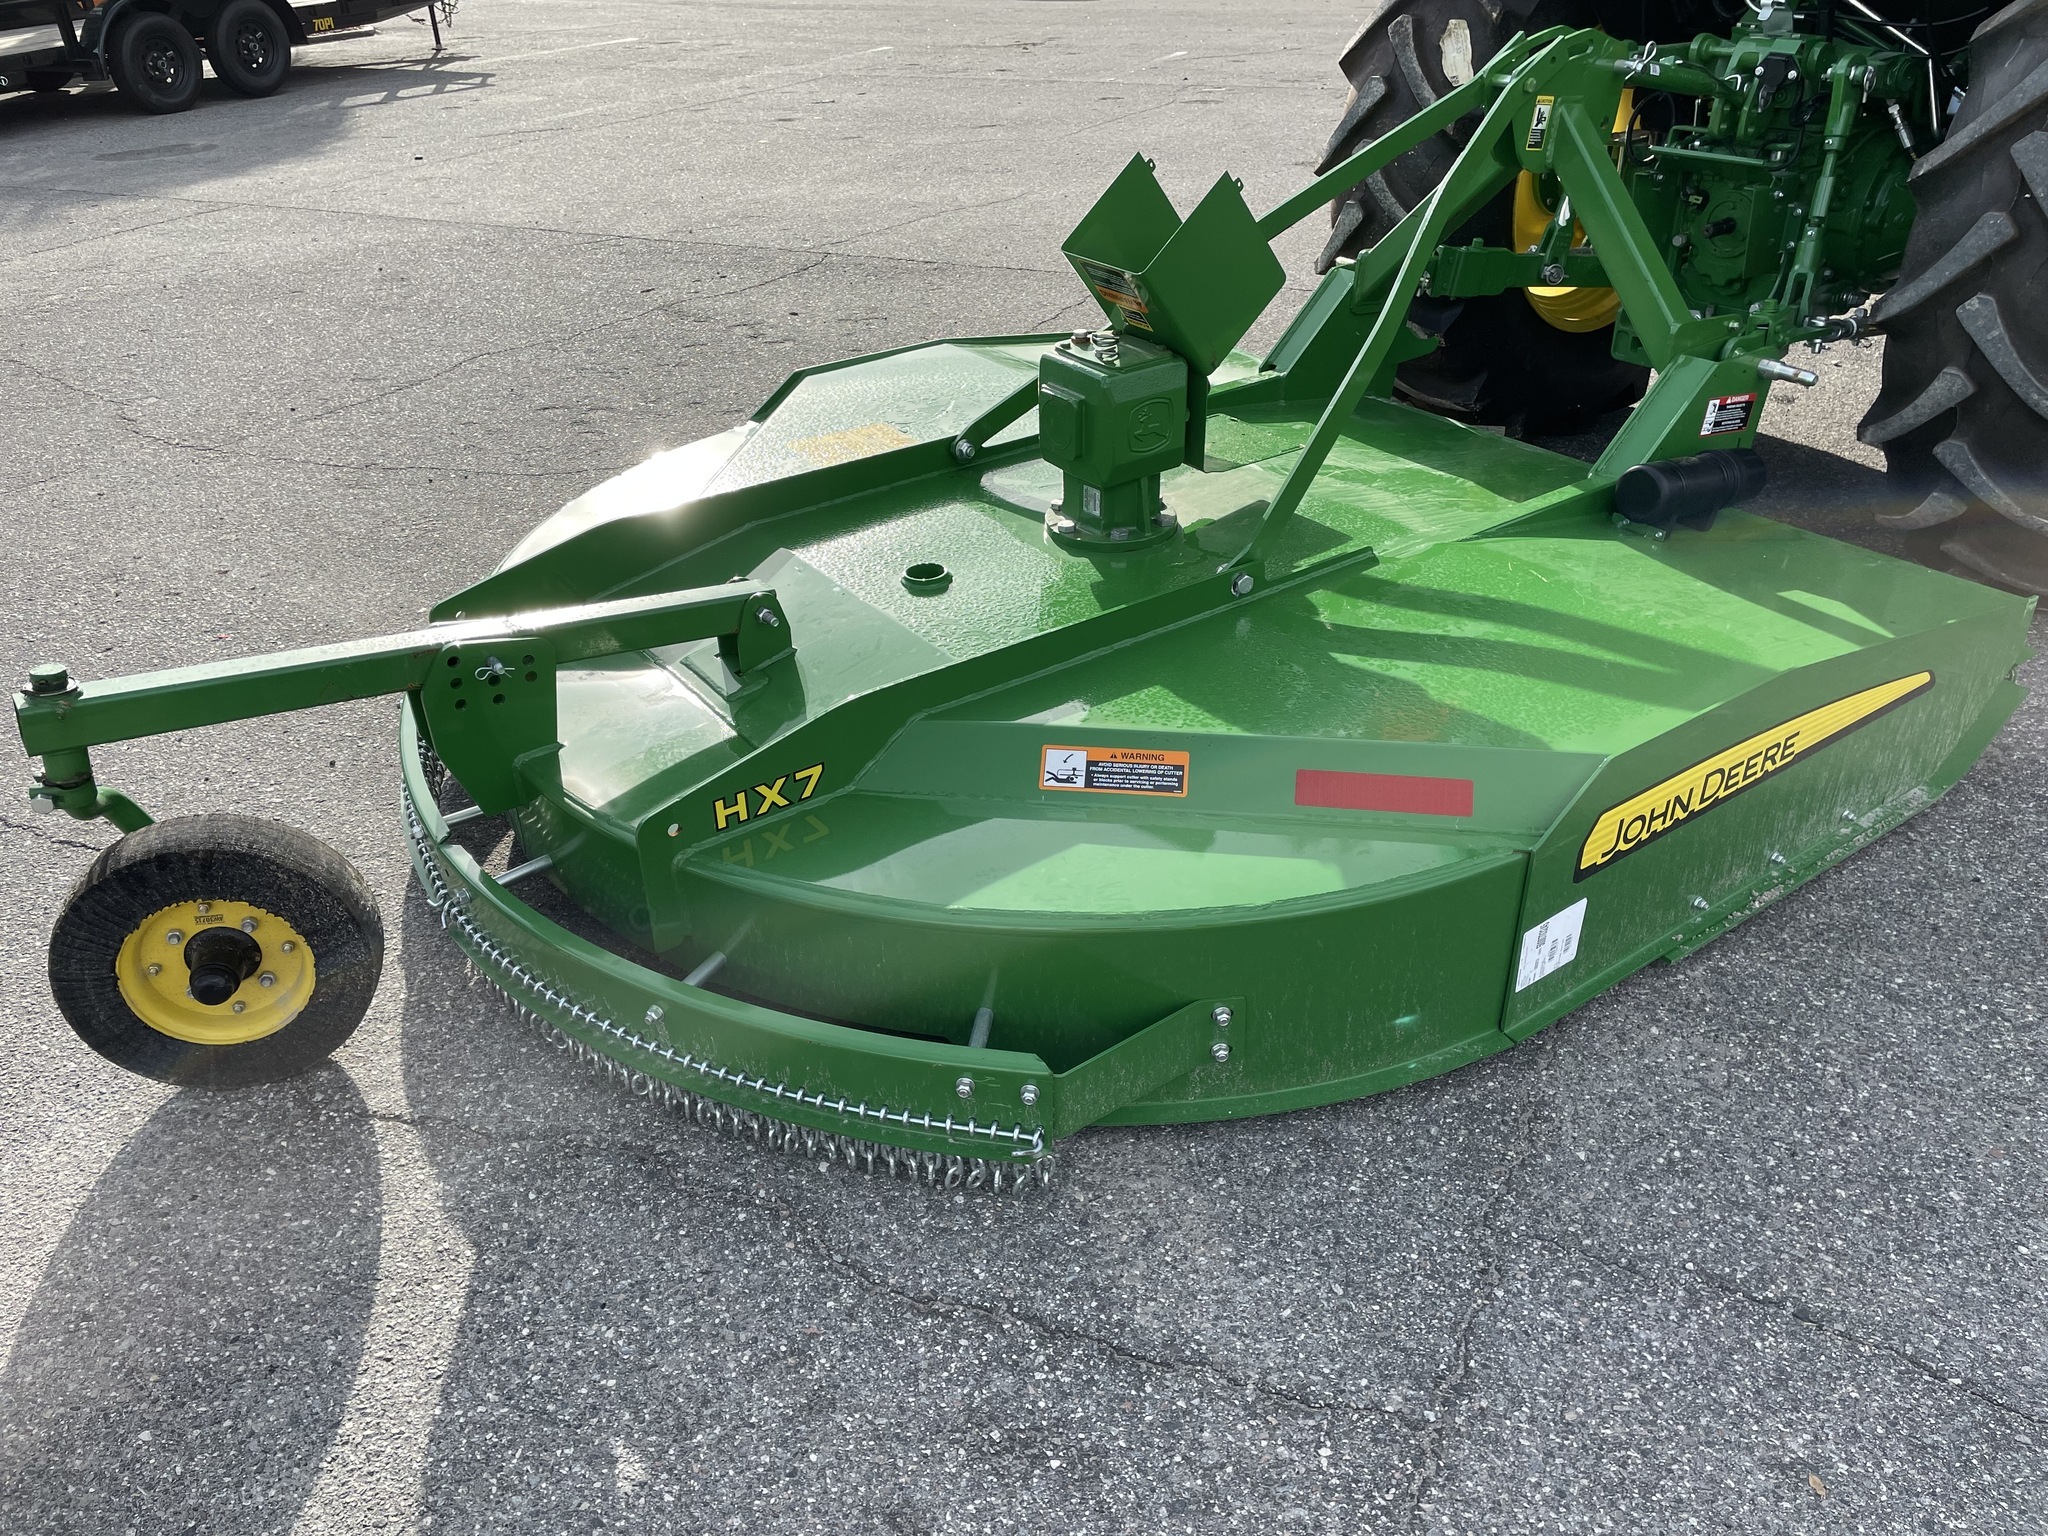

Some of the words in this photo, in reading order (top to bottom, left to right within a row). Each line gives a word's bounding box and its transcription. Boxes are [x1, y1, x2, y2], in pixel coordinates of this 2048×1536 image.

[312, 17, 335, 32] 70PI
[1121, 752, 1165, 762] WARNING
[713, 762, 825, 833] HX7
[1600, 787, 1695, 859] JOHN
[1700, 730, 1801, 802] DEERE
